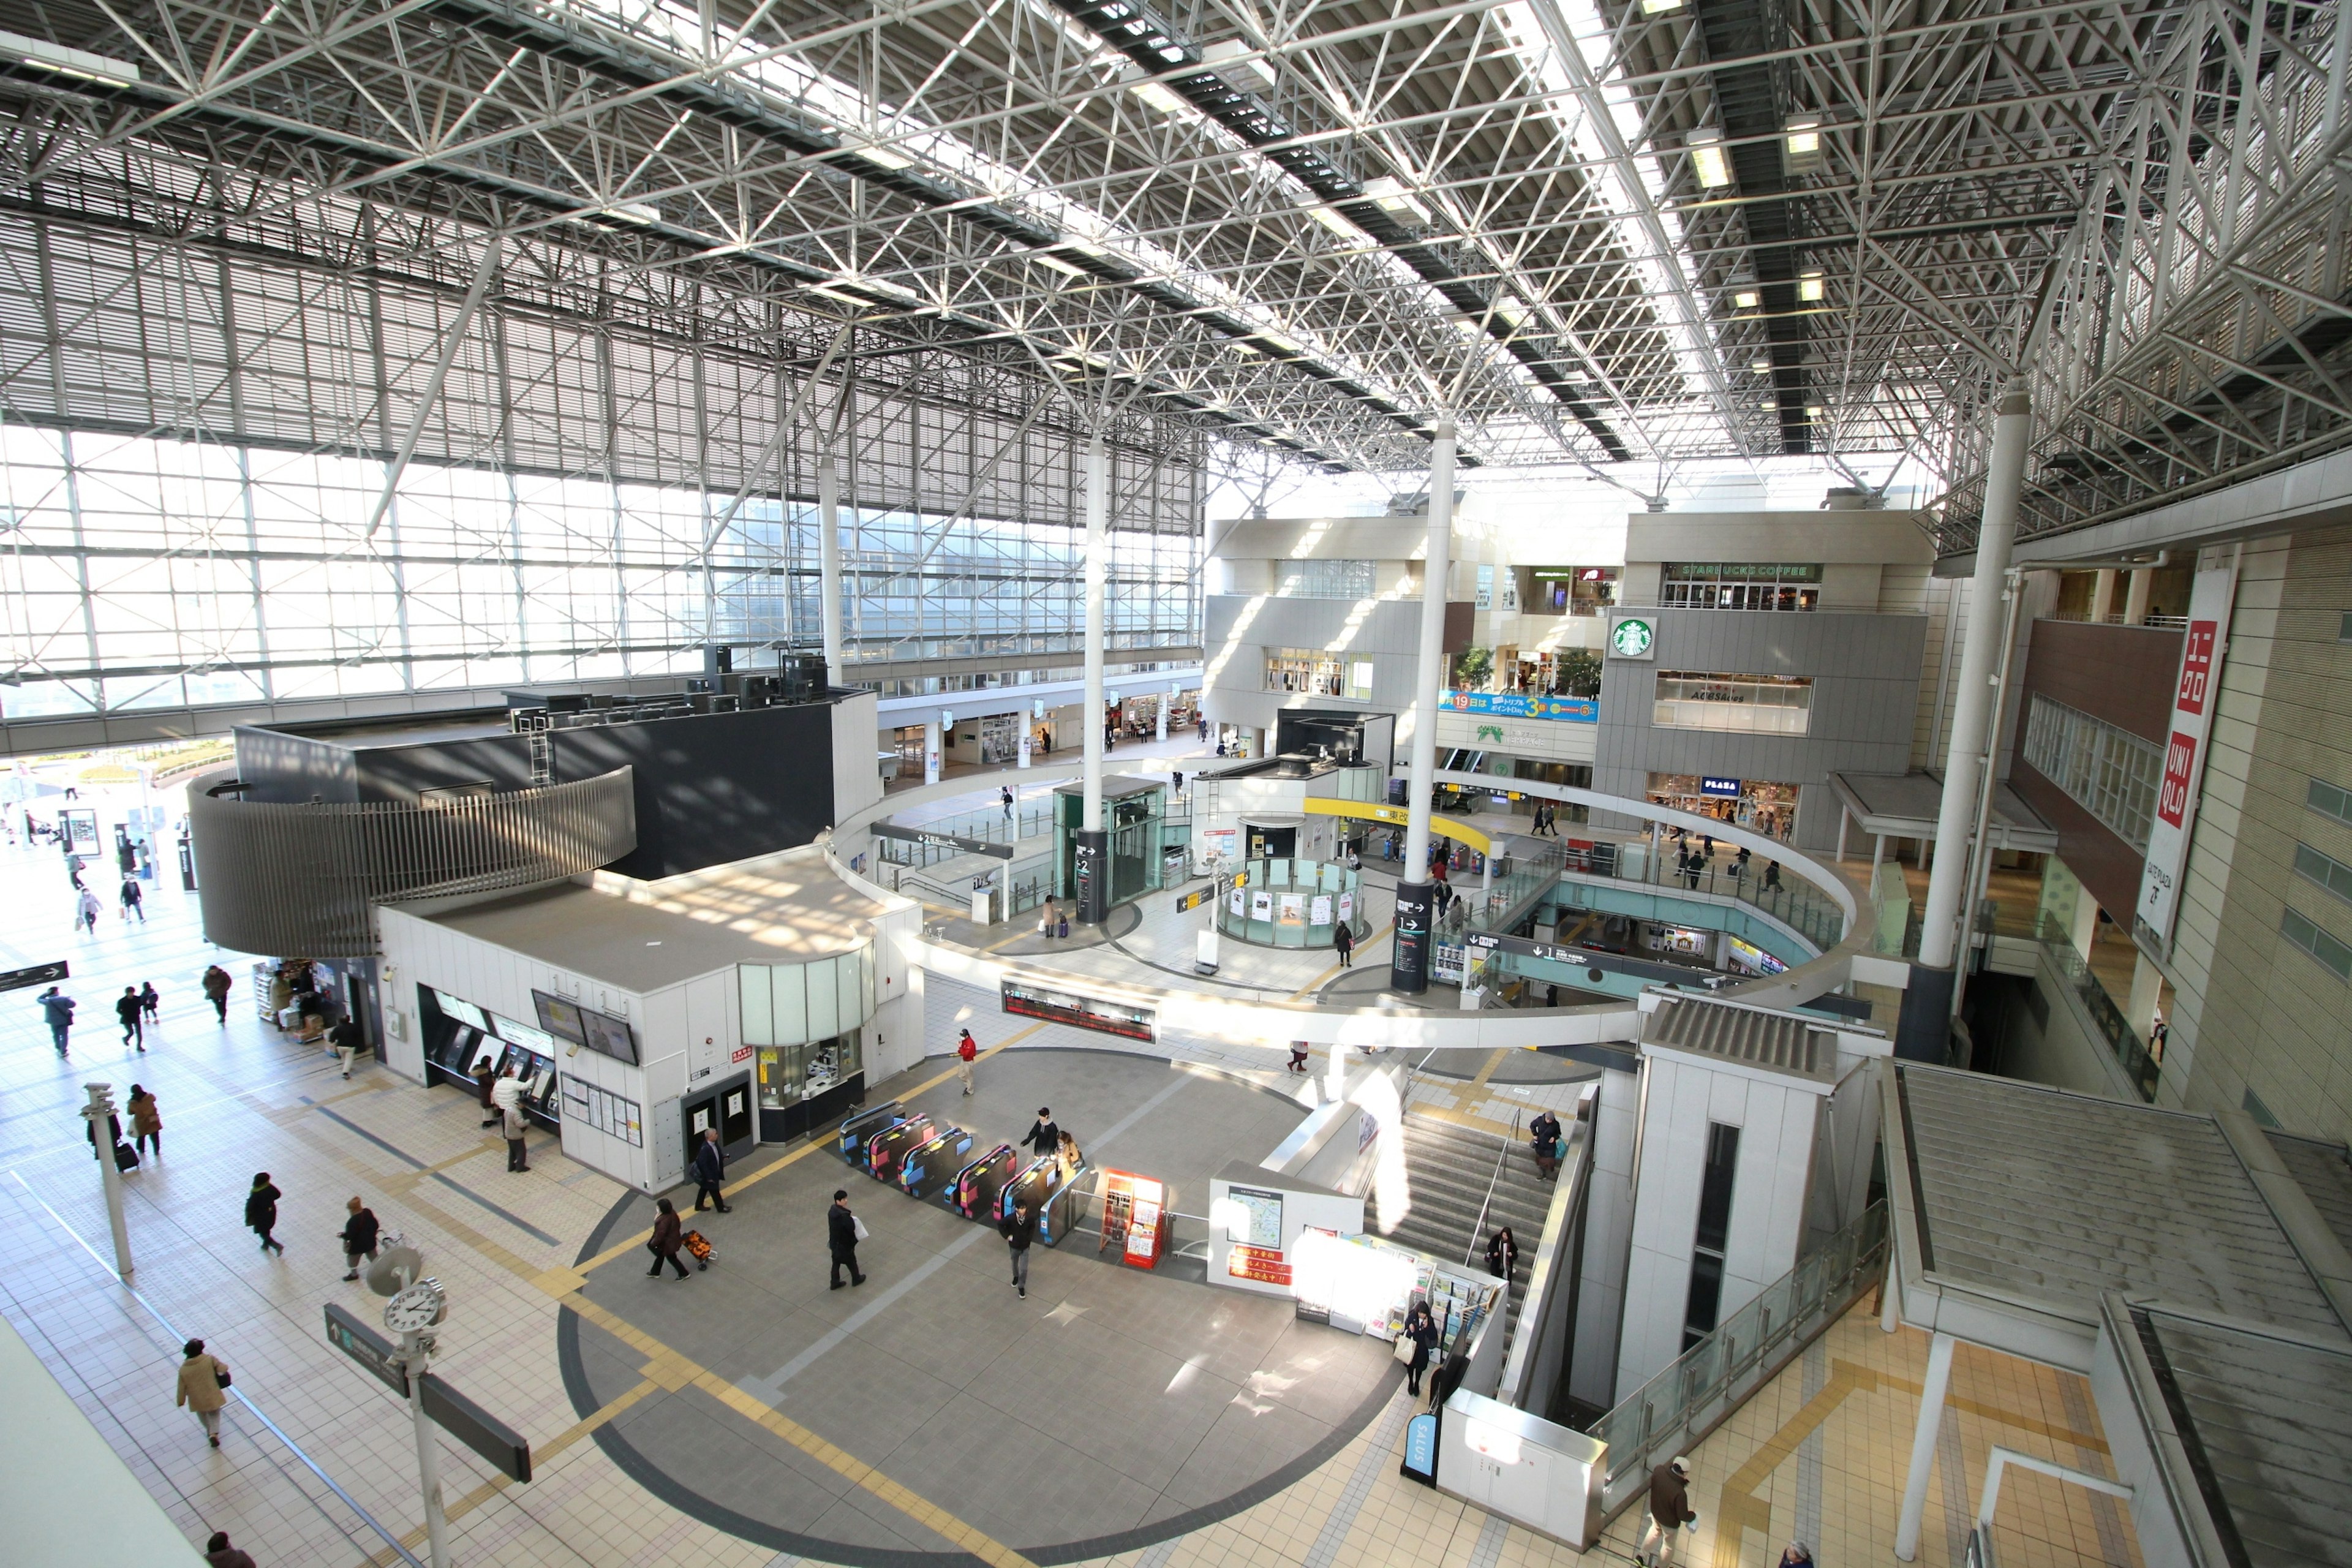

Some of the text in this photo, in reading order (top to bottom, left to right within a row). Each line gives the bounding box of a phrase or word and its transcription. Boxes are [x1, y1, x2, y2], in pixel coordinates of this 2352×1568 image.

[1583, 570, 1599, 581] JTB
[1683, 565, 1807, 576] STARBUCKS COFFEE
[2169, 742, 2191, 778] UNI
[1705, 780, 1736, 791] PLAZA
[2162, 779, 2185, 816] QLO
[1081, 860, 1088, 870] 2
[1414, 1423, 1428, 1463] SALUS
